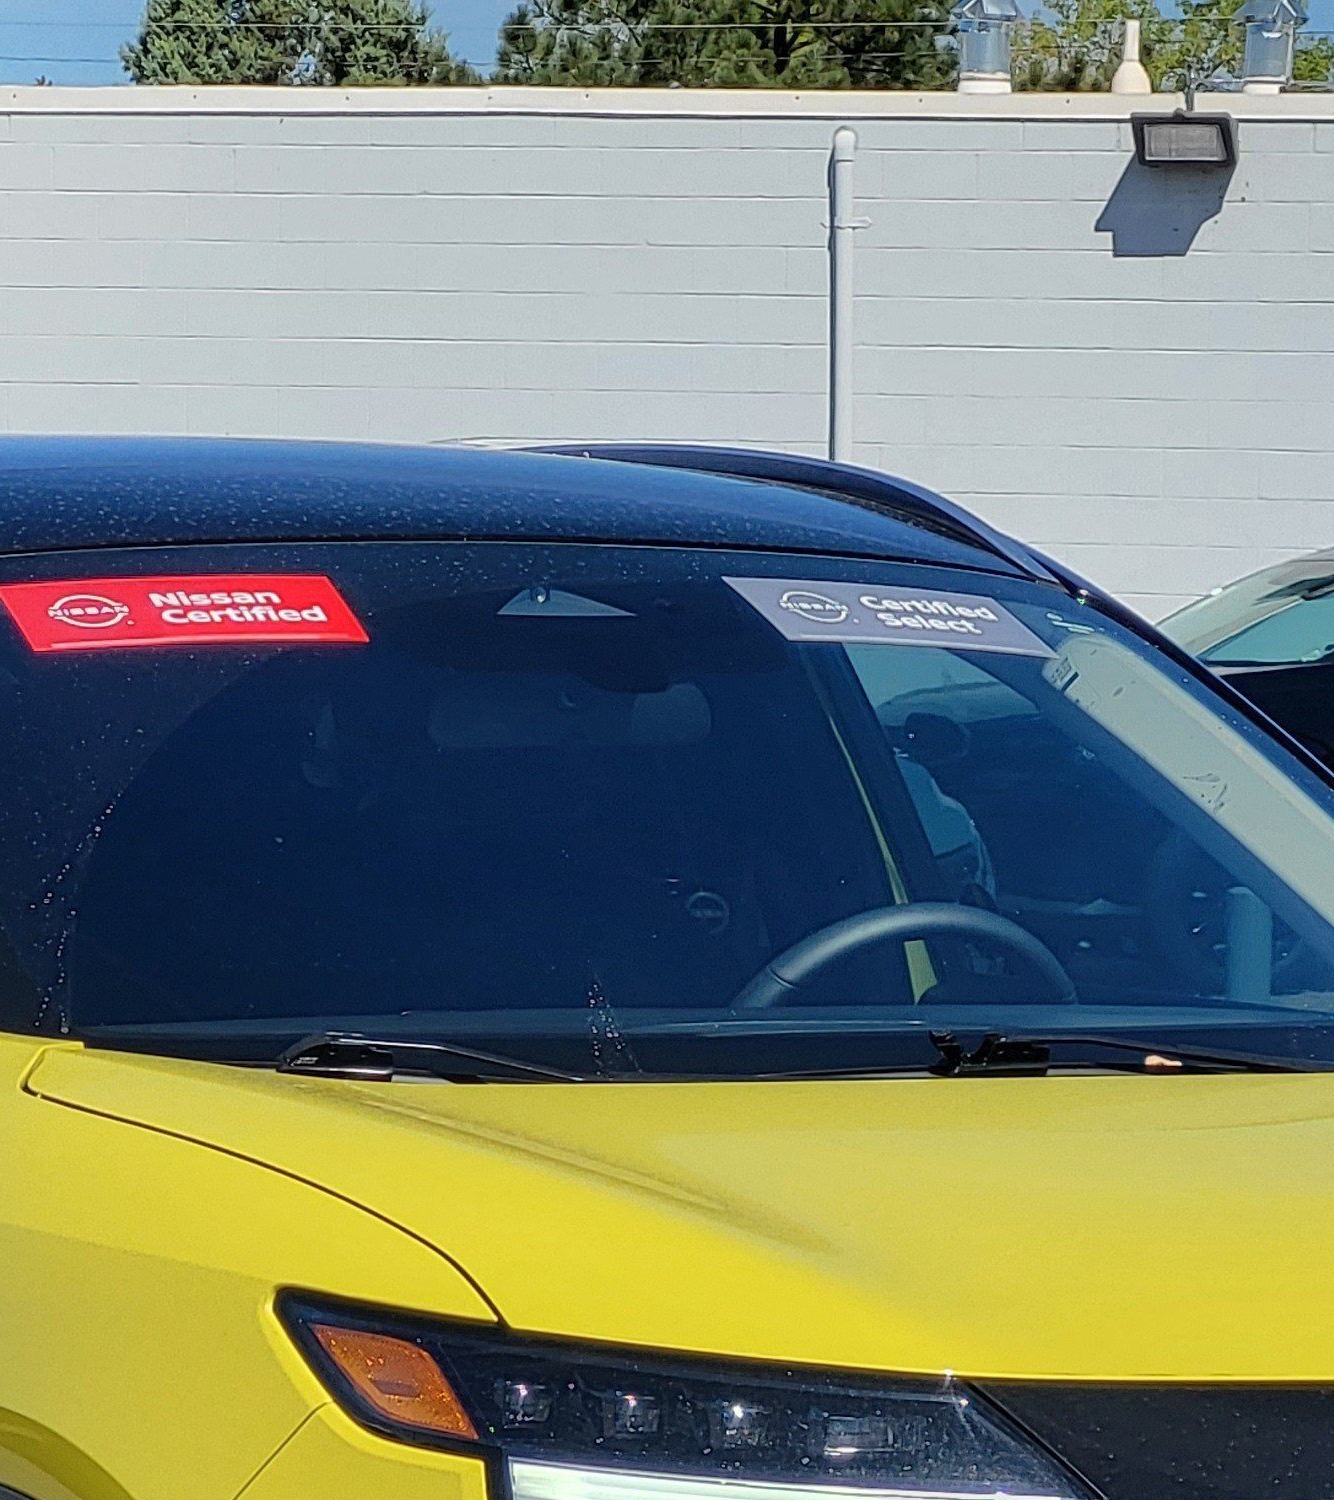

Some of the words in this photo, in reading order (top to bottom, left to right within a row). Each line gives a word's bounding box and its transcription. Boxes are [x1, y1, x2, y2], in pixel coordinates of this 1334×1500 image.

[148, 589, 281, 608] Nissan
[779, 600, 849, 615] NISSAN
[858, 594, 999, 623] Certified
[47, 604, 130, 619] NISSAN
[161, 604, 328, 625] Certified
[876, 612, 983, 636] Select
